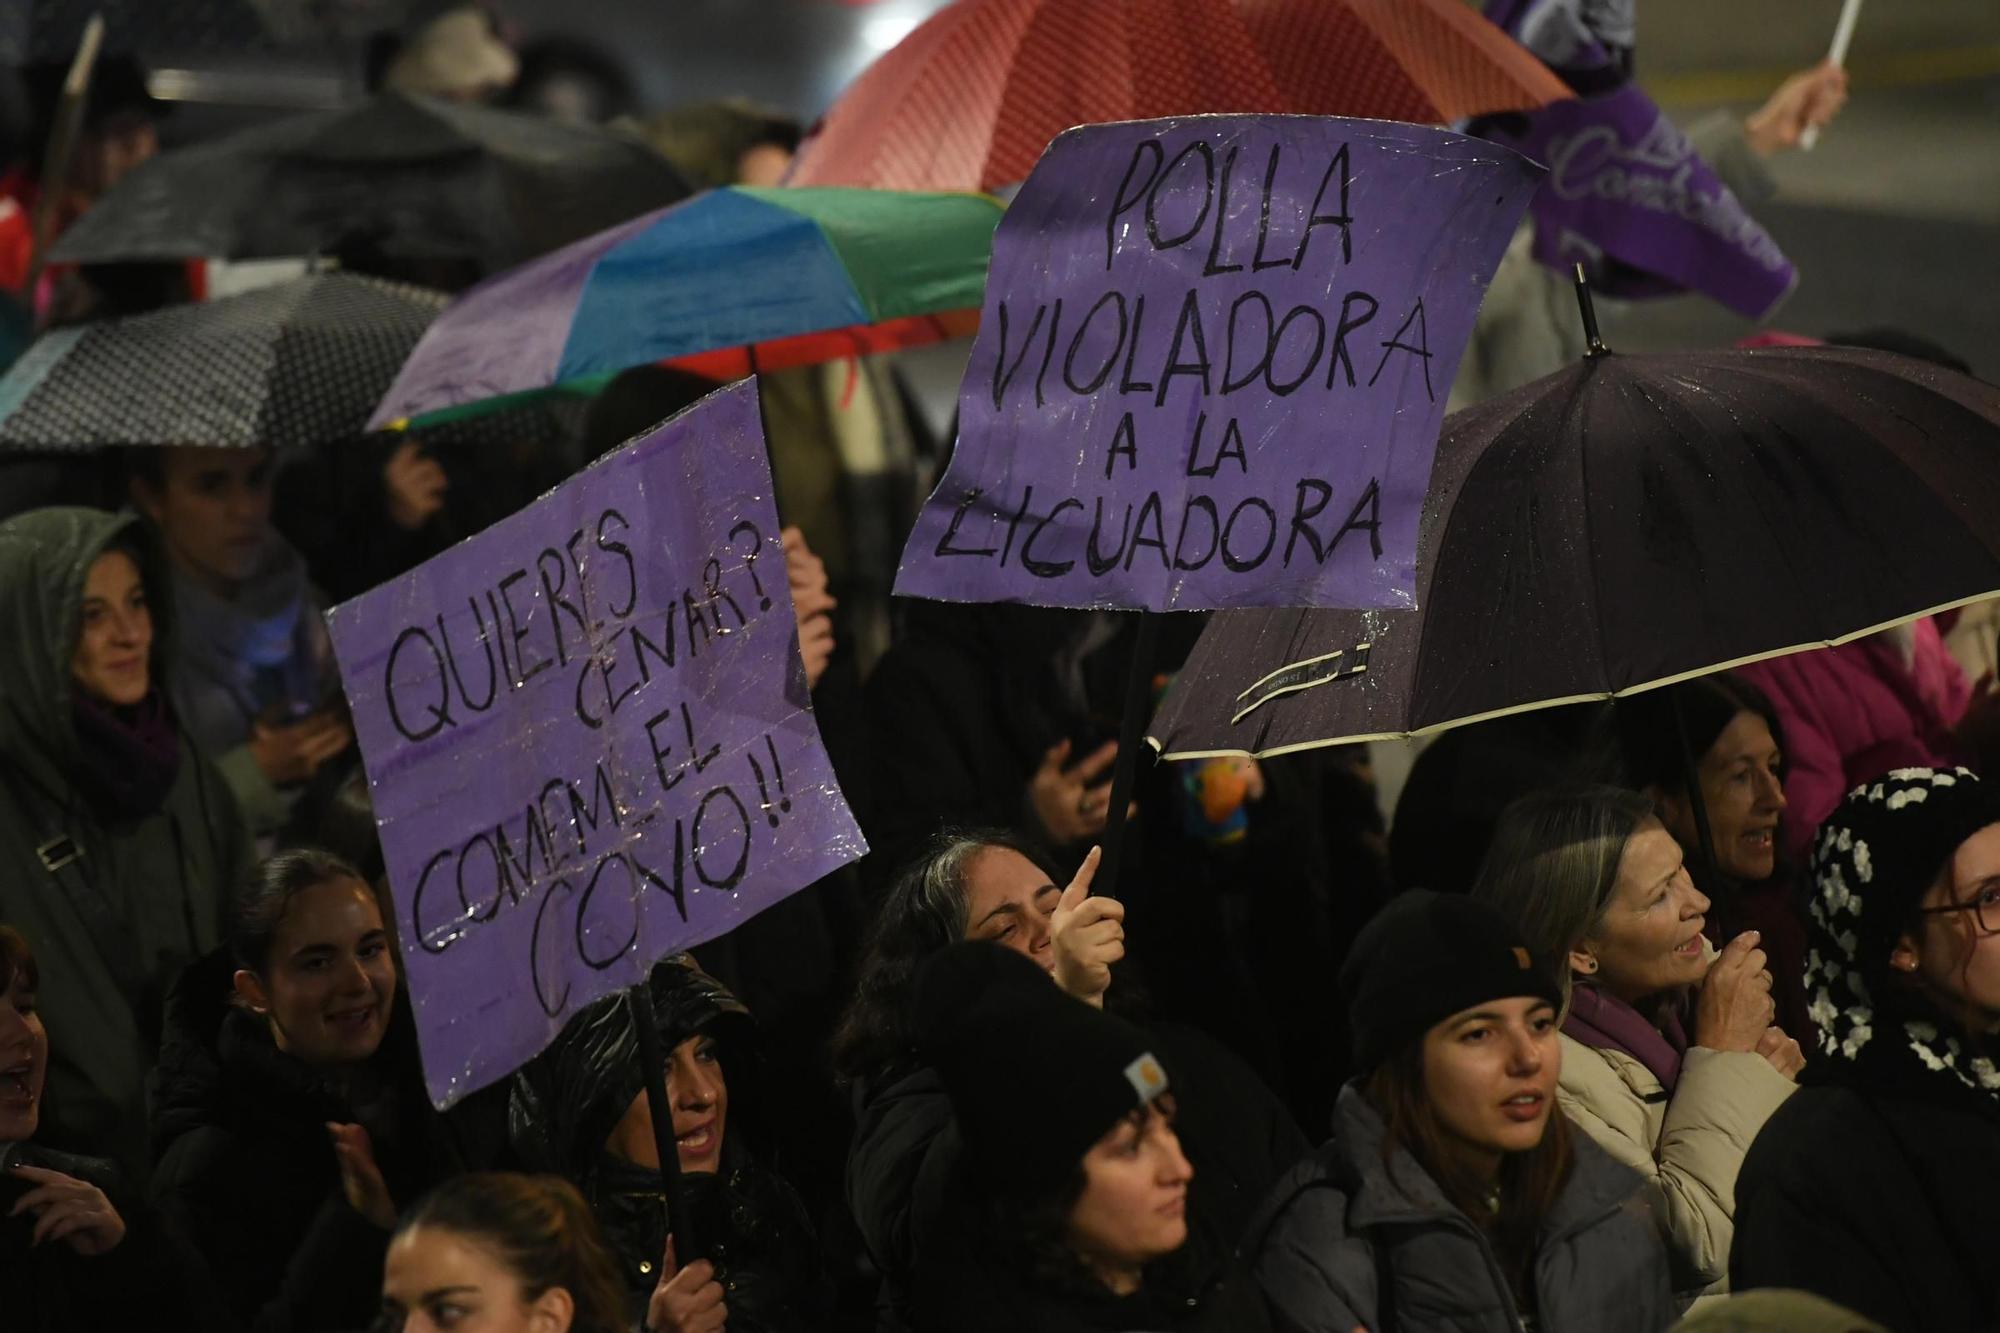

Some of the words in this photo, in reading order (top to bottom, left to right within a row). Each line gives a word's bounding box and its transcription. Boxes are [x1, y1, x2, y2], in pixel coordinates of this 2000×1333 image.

[1106, 138, 1355, 277] POLLA
[992, 288, 1436, 412] VIOLADORA
[1105, 412, 1138, 480] A
[1187, 413, 1248, 479] LA
[935, 476, 1383, 578] LICUADORA
[385, 508, 638, 742] QUIERES
[575, 520, 773, 730] CENAR?
[645, 701, 721, 791] EL
